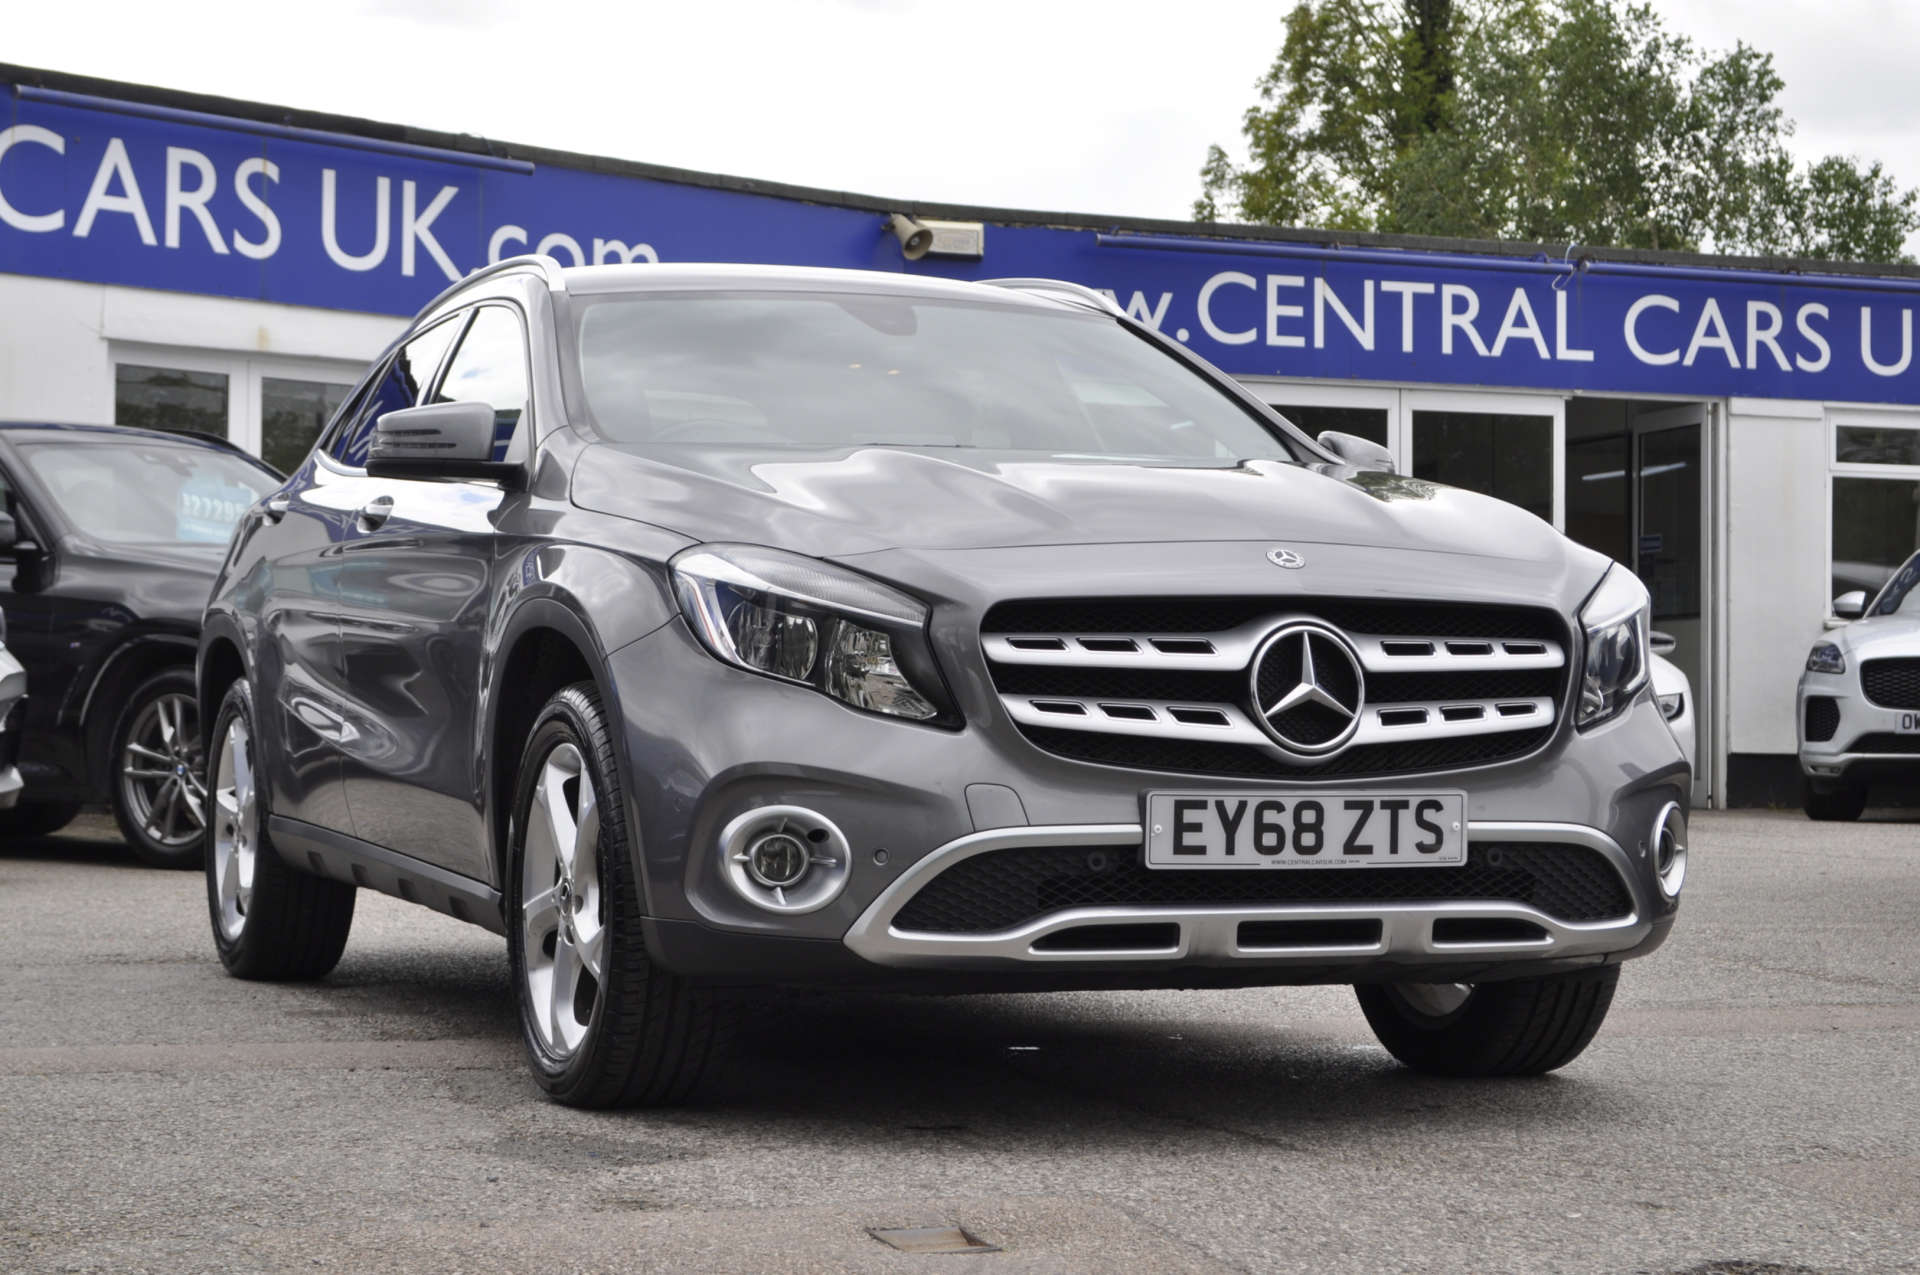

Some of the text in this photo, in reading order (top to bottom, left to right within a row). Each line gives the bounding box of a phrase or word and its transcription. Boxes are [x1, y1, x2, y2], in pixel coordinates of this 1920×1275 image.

[0, 124, 282, 260] CARS
[1095, 271, 1594, 361] w.CENTRAL
[1624, 294, 1829, 373] CARS
[1173, 799, 1444, 855] EY68 ZTS
